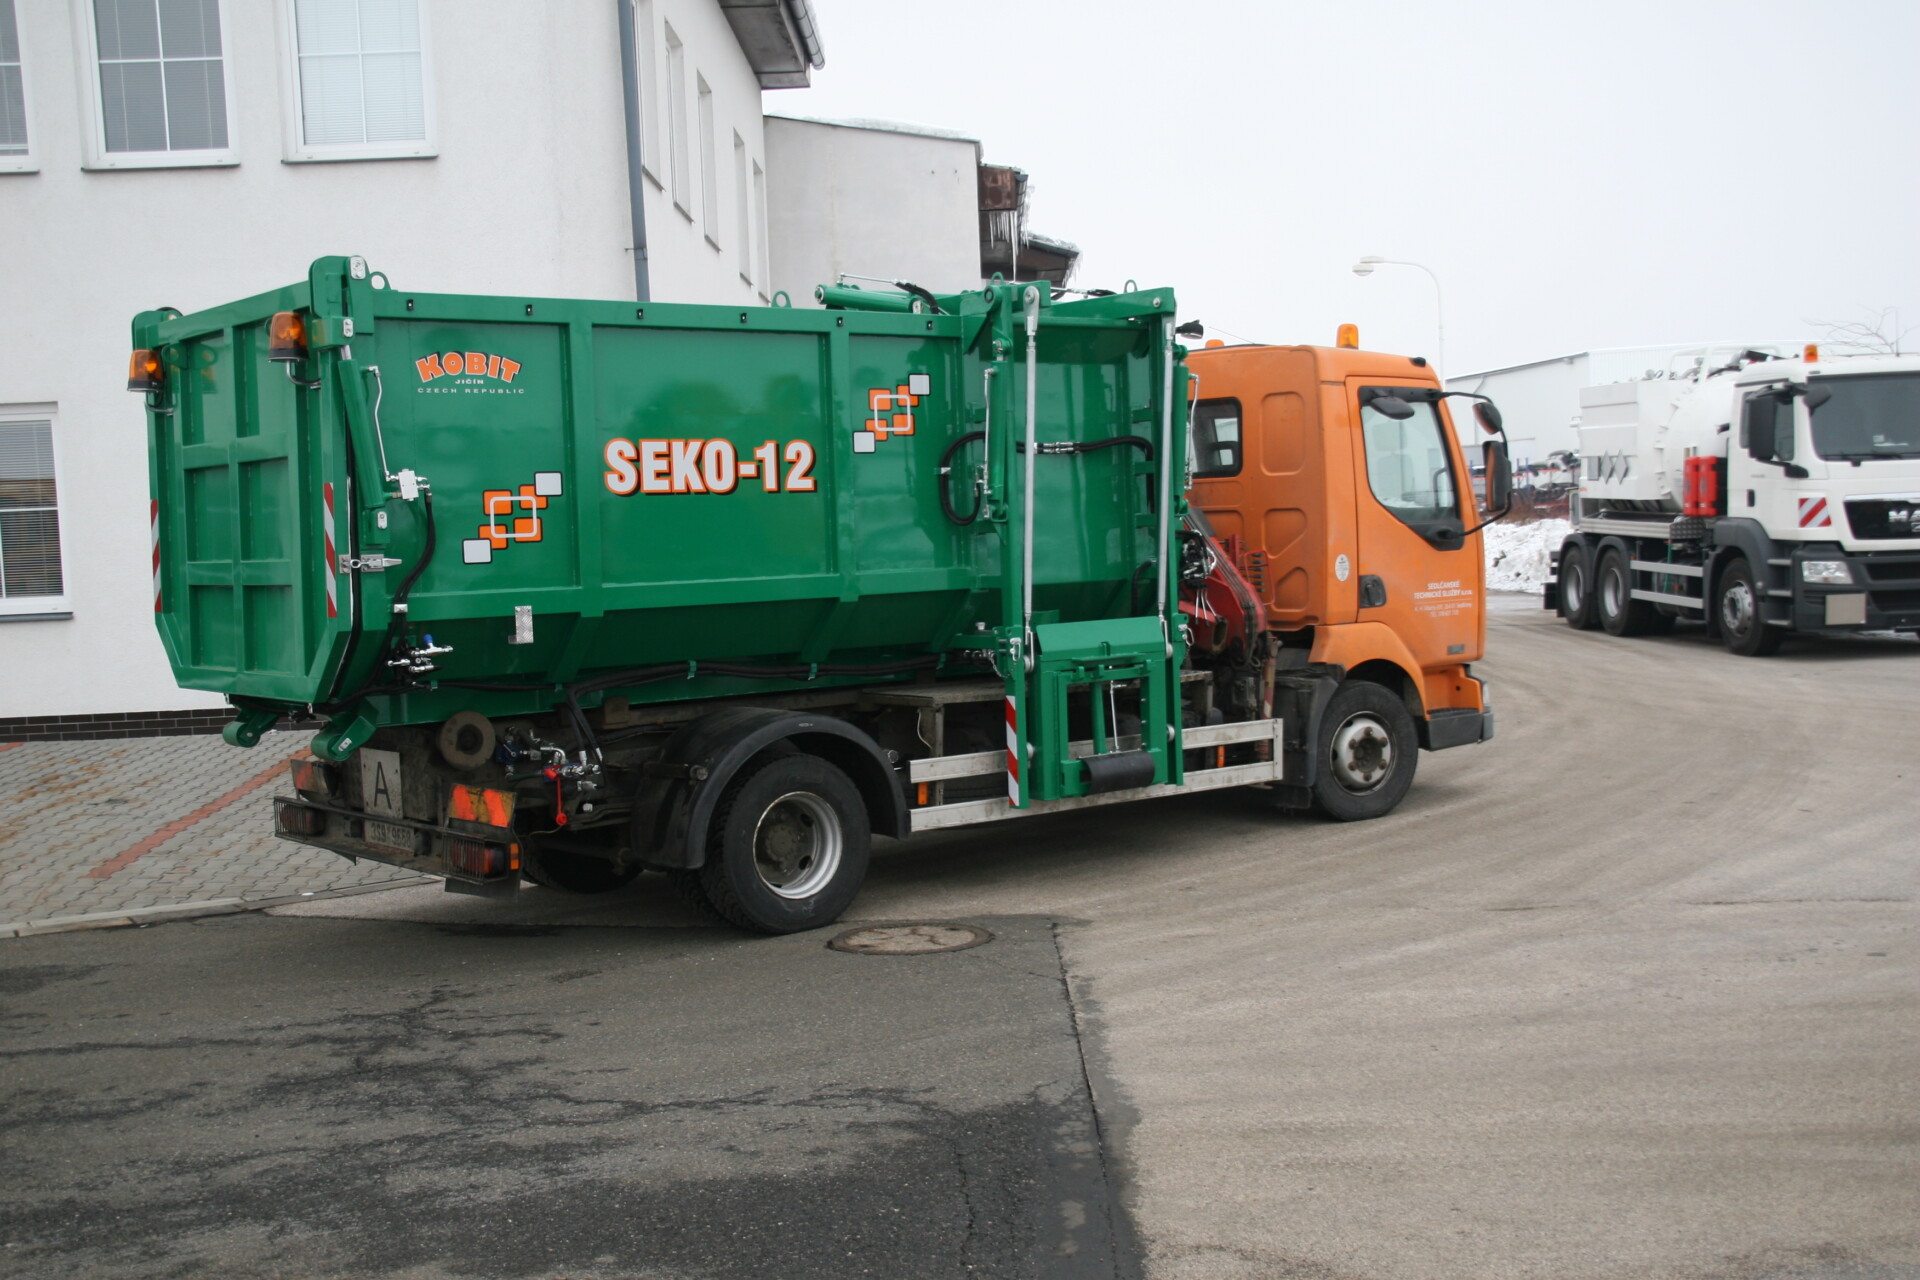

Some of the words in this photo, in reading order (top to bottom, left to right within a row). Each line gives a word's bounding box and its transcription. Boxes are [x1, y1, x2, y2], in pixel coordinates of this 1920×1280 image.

[415, 351, 522, 383] KOBIT
[603, 437, 817, 496] SEKO-12
[373, 761, 392, 810] A
